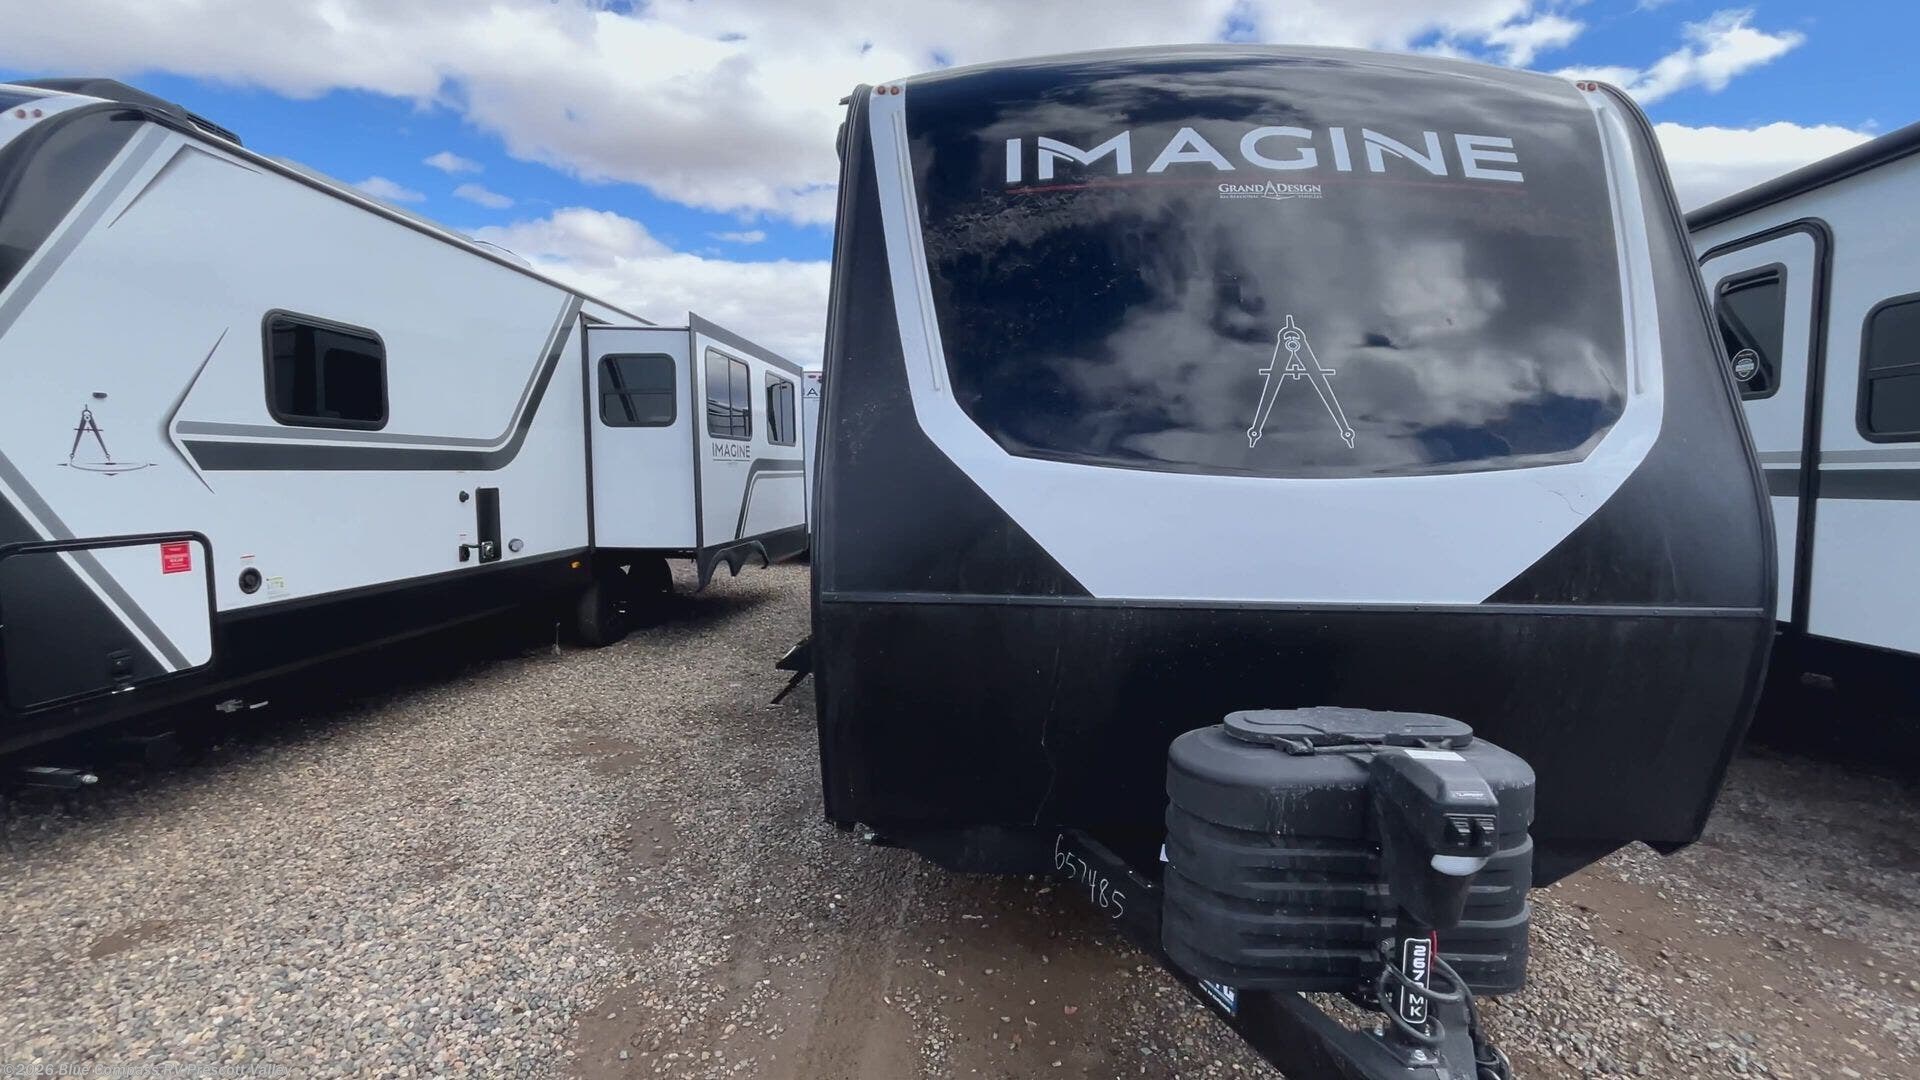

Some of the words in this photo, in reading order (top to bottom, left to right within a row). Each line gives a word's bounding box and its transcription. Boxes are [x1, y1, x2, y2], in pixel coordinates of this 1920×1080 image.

[1005, 126, 1525, 183] IMAGINE
[711, 442, 751, 458] IMAGINE
[1055, 833, 1127, 919] 657485
